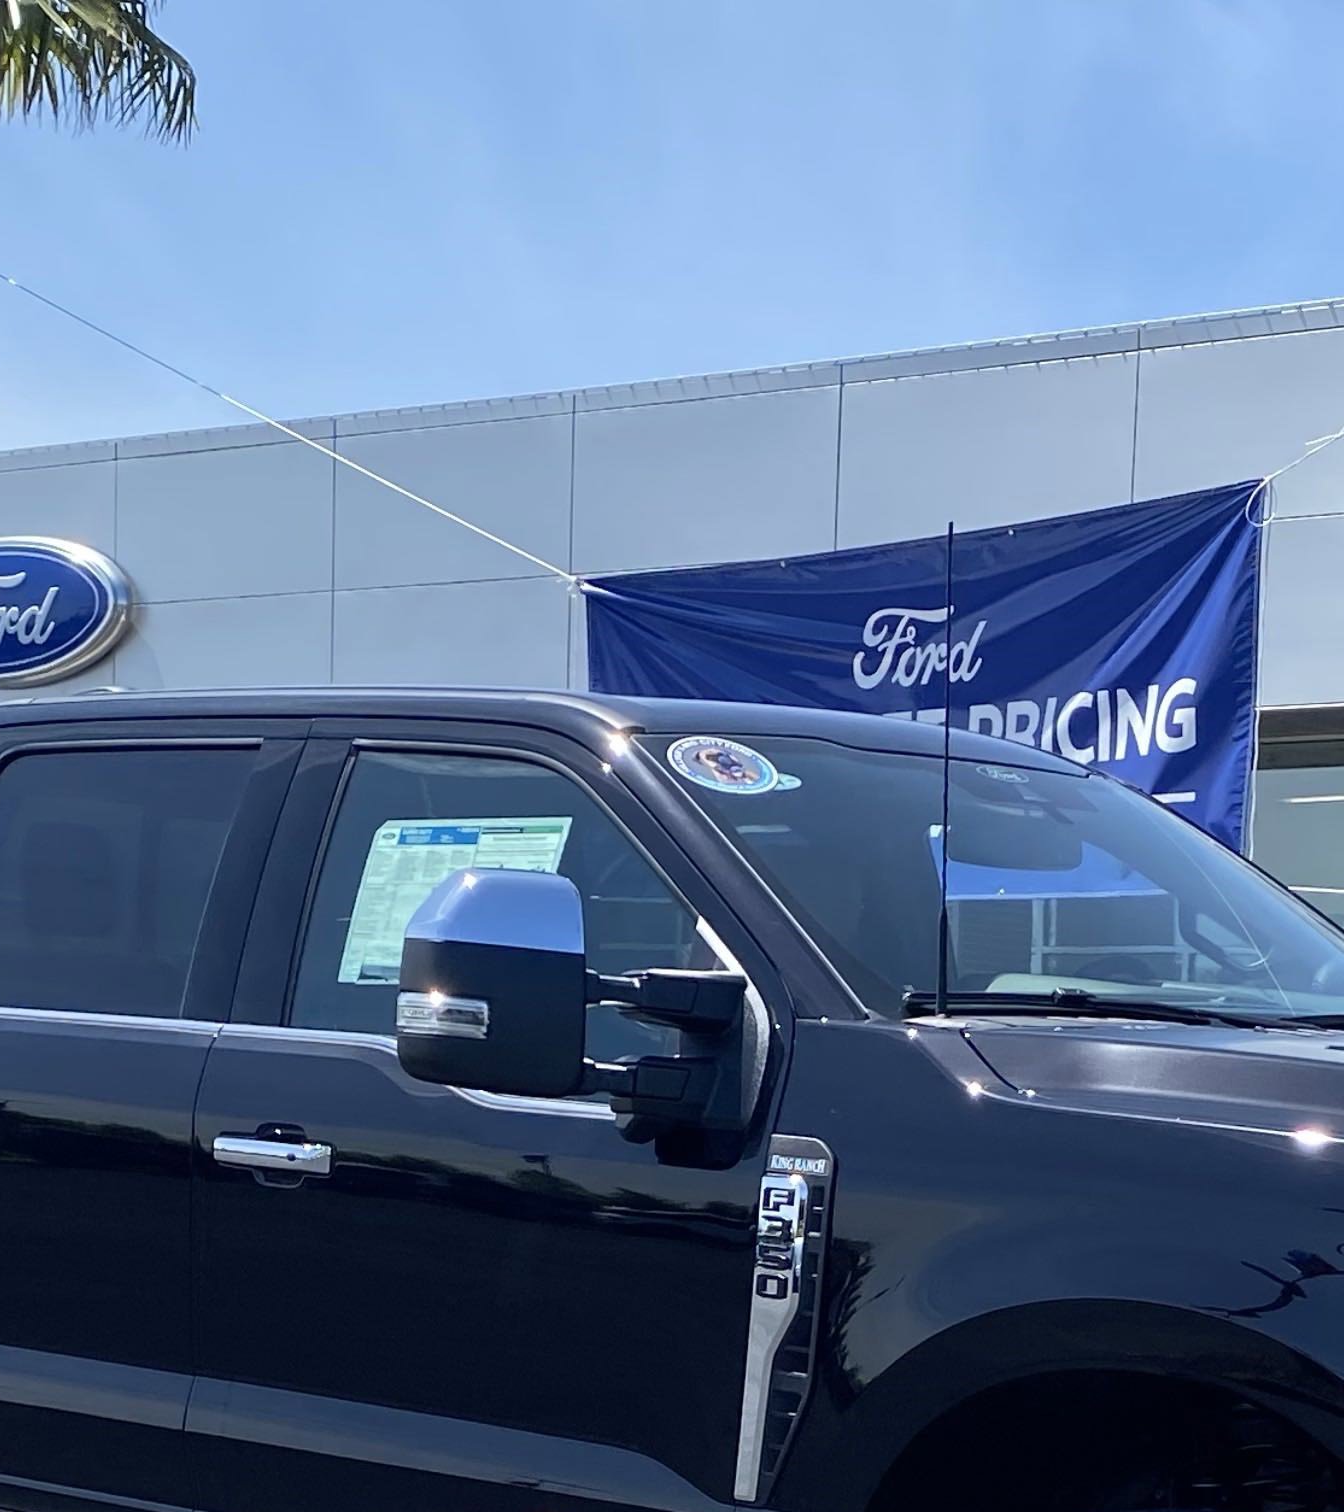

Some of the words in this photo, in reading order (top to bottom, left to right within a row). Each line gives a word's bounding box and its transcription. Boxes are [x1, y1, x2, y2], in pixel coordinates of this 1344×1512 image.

[853, 605, 988, 690] Ford
[771, 1155, 794, 1171] KING
[794, 1158, 826, 1174] RANCH
